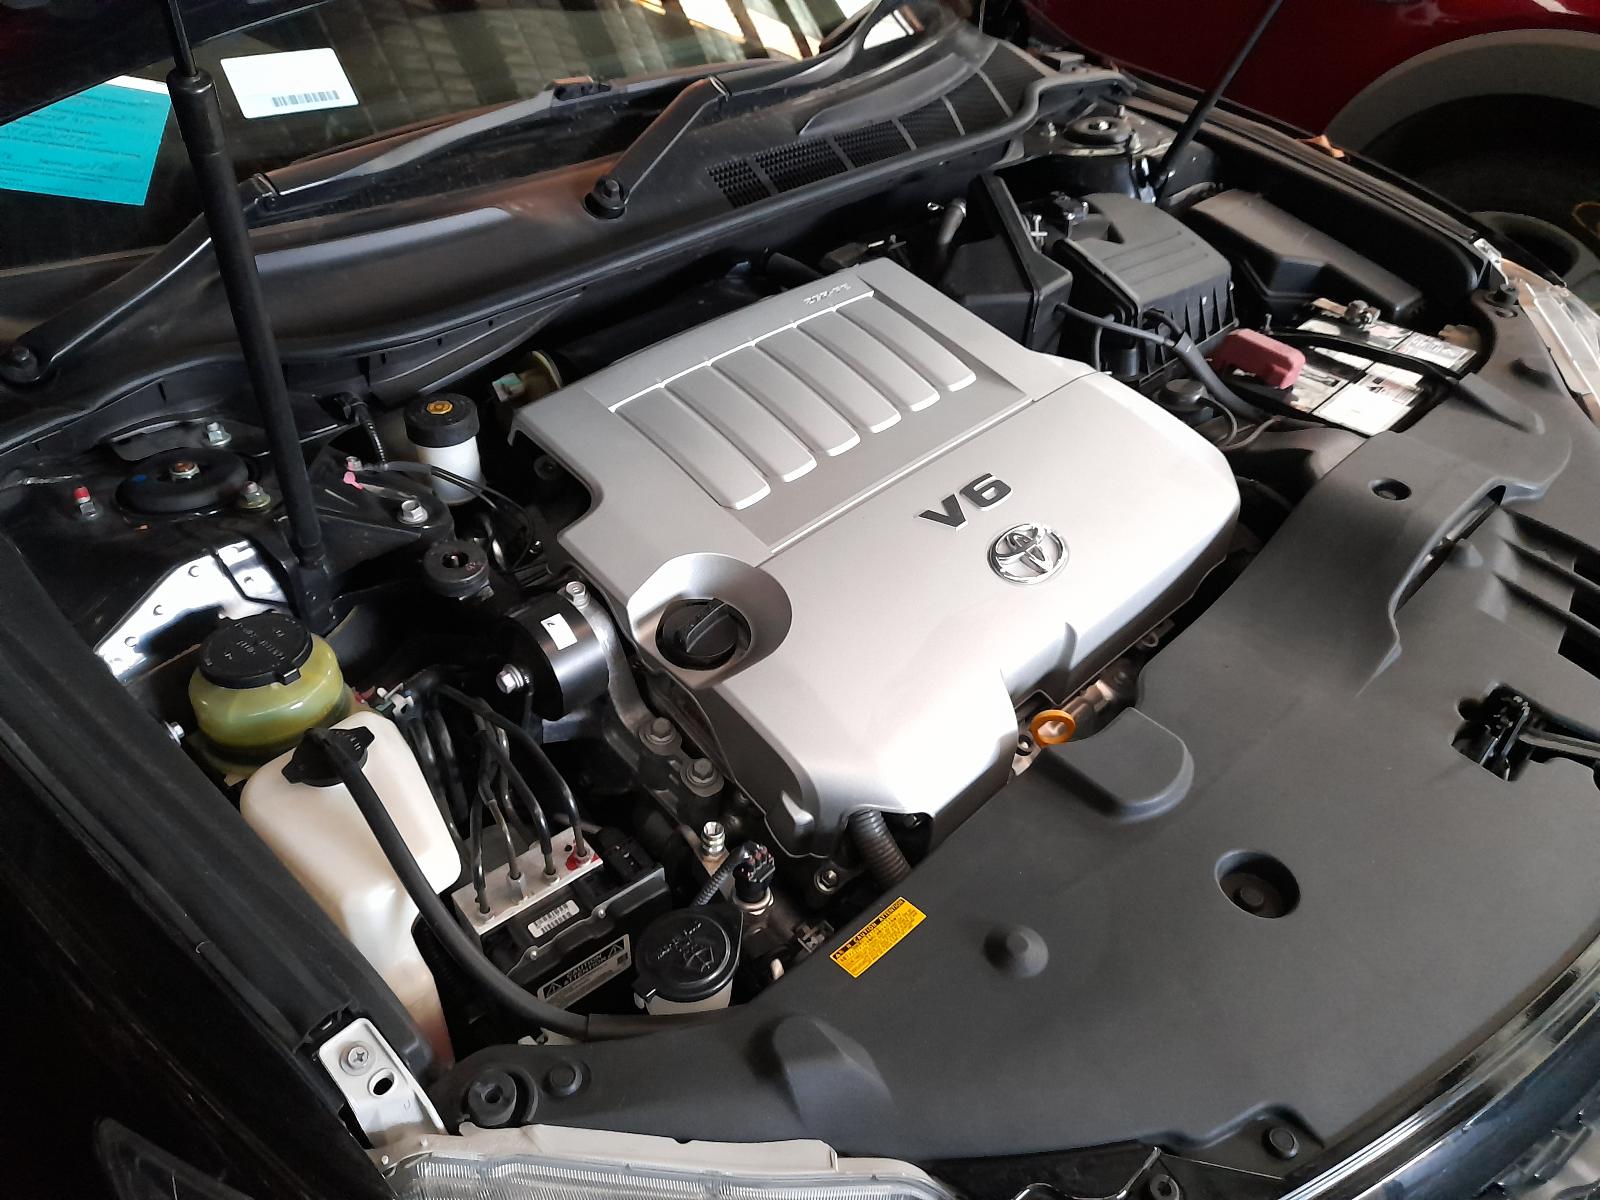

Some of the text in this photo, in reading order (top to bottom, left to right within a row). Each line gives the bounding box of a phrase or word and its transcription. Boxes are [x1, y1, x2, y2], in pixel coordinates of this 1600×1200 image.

[918, 473, 1012, 529] V6
[853, 922, 877, 943] CAUTION
[563, 956, 607, 986] ATTENTION
[565, 953, 602, 979] CAUTION
